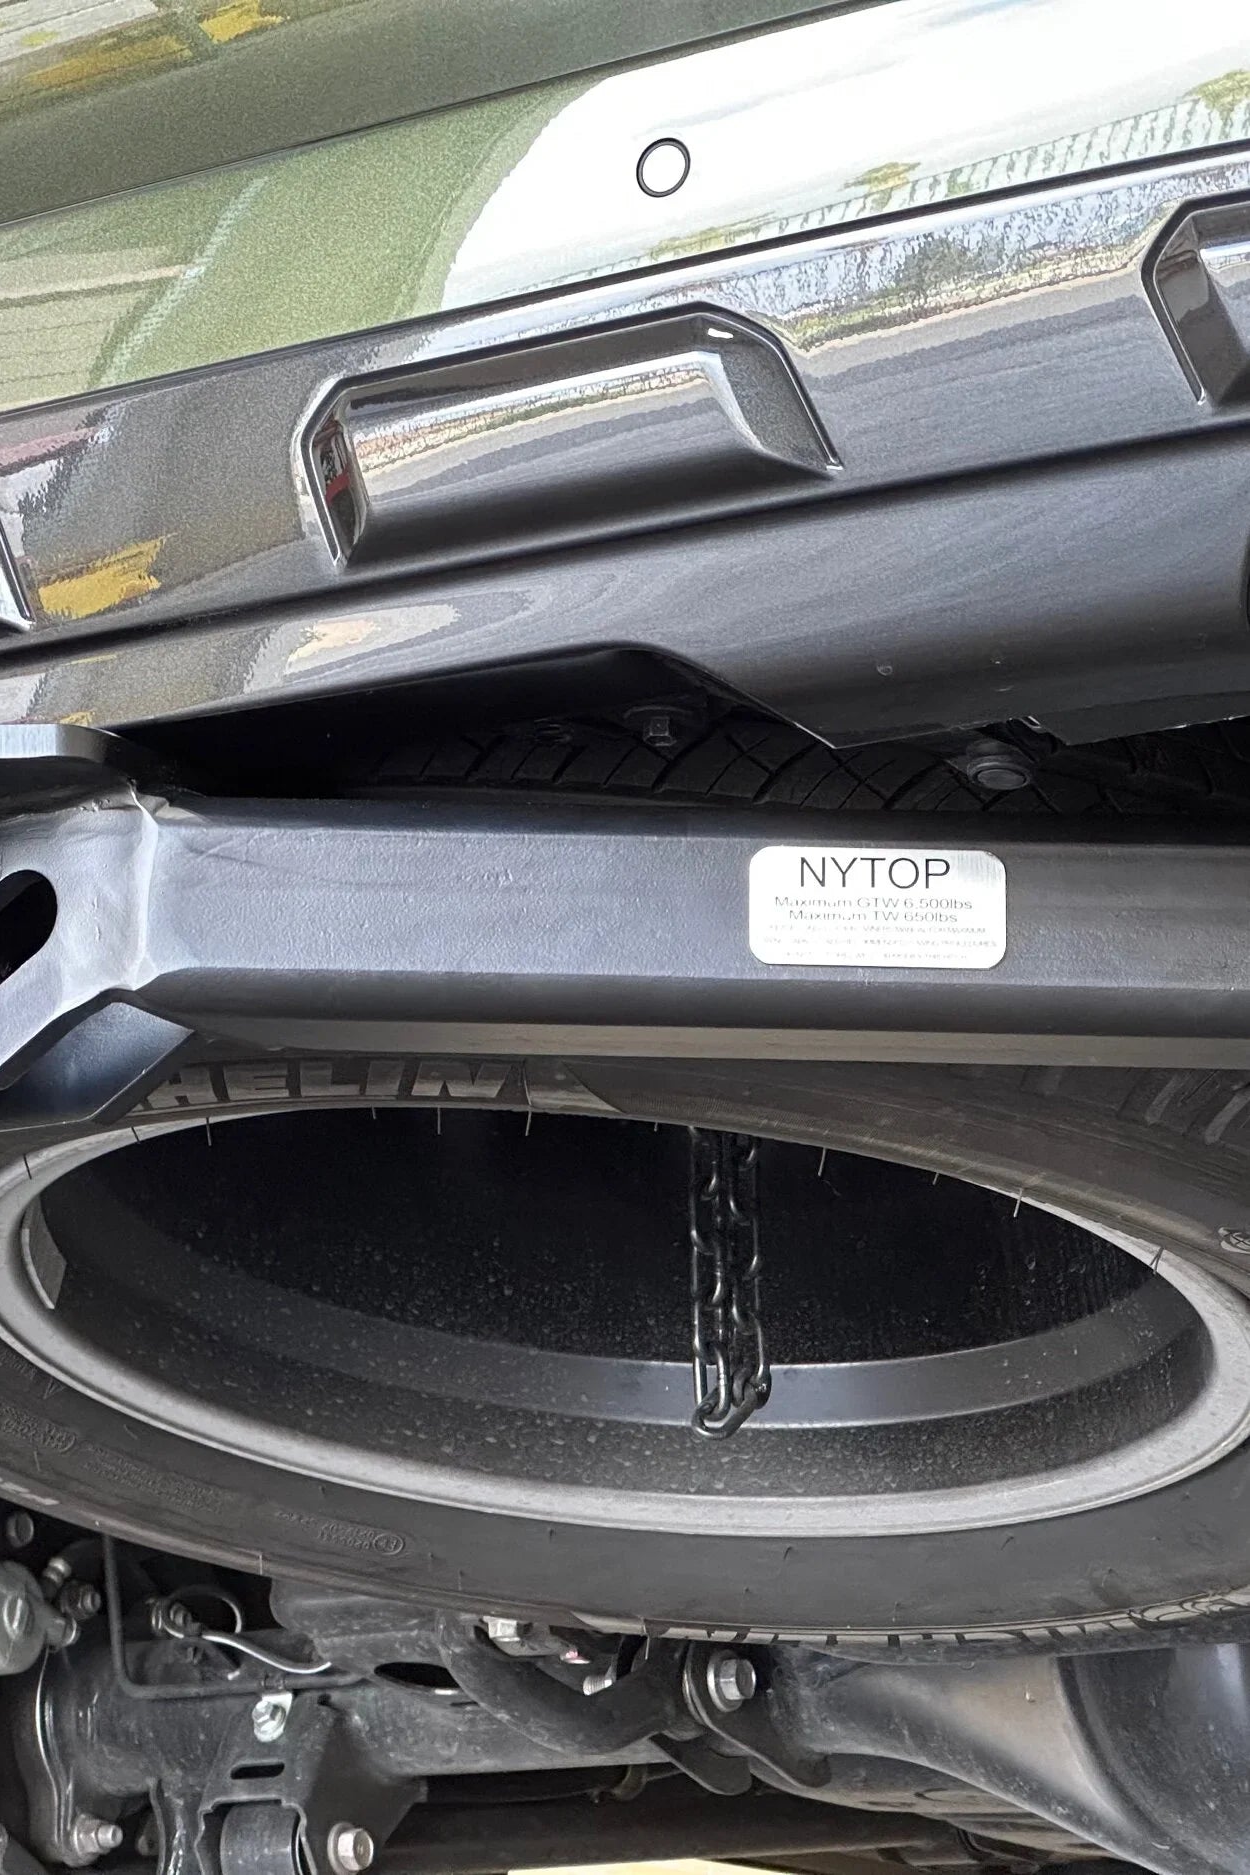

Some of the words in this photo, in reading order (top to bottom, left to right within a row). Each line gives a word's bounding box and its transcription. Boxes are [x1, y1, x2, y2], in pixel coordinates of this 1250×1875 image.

[800, 856, 951, 889] NYTOP
[774, 896, 853, 909] Maximum
[857, 897, 900, 910] GTW
[788, 909, 867, 922] Maximum
[873, 910, 900, 922] TW
[904, 911, 958, 923] 650lbs
[131, 1060, 514, 1110] HELIN
